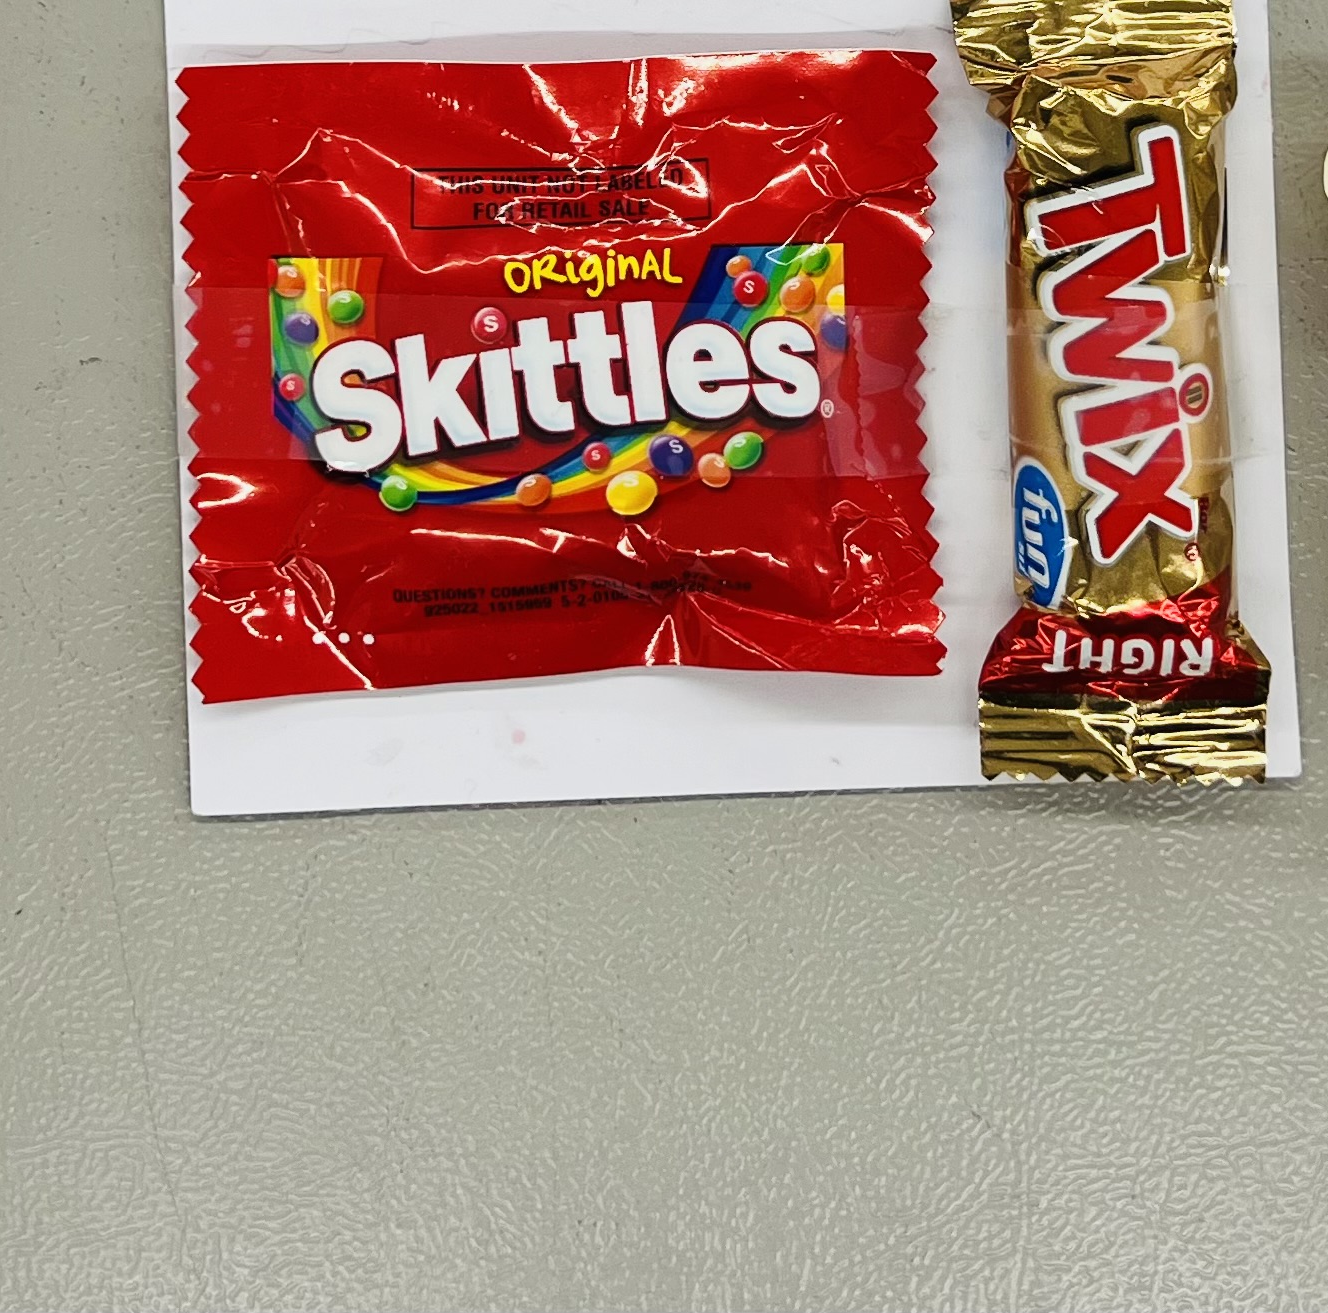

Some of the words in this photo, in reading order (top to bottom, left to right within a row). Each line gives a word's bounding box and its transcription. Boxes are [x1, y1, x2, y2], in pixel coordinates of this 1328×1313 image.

[492, 174, 538, 194] UNIT
[547, 173, 589, 193] NOT
[522, 200, 590, 219] RETAIL
[599, 199, 649, 217] SALE
[311, 301, 822, 473] Skittles
[1022, 487, 1058, 589] fun
[1041, 629, 1214, 677] RIGHT
